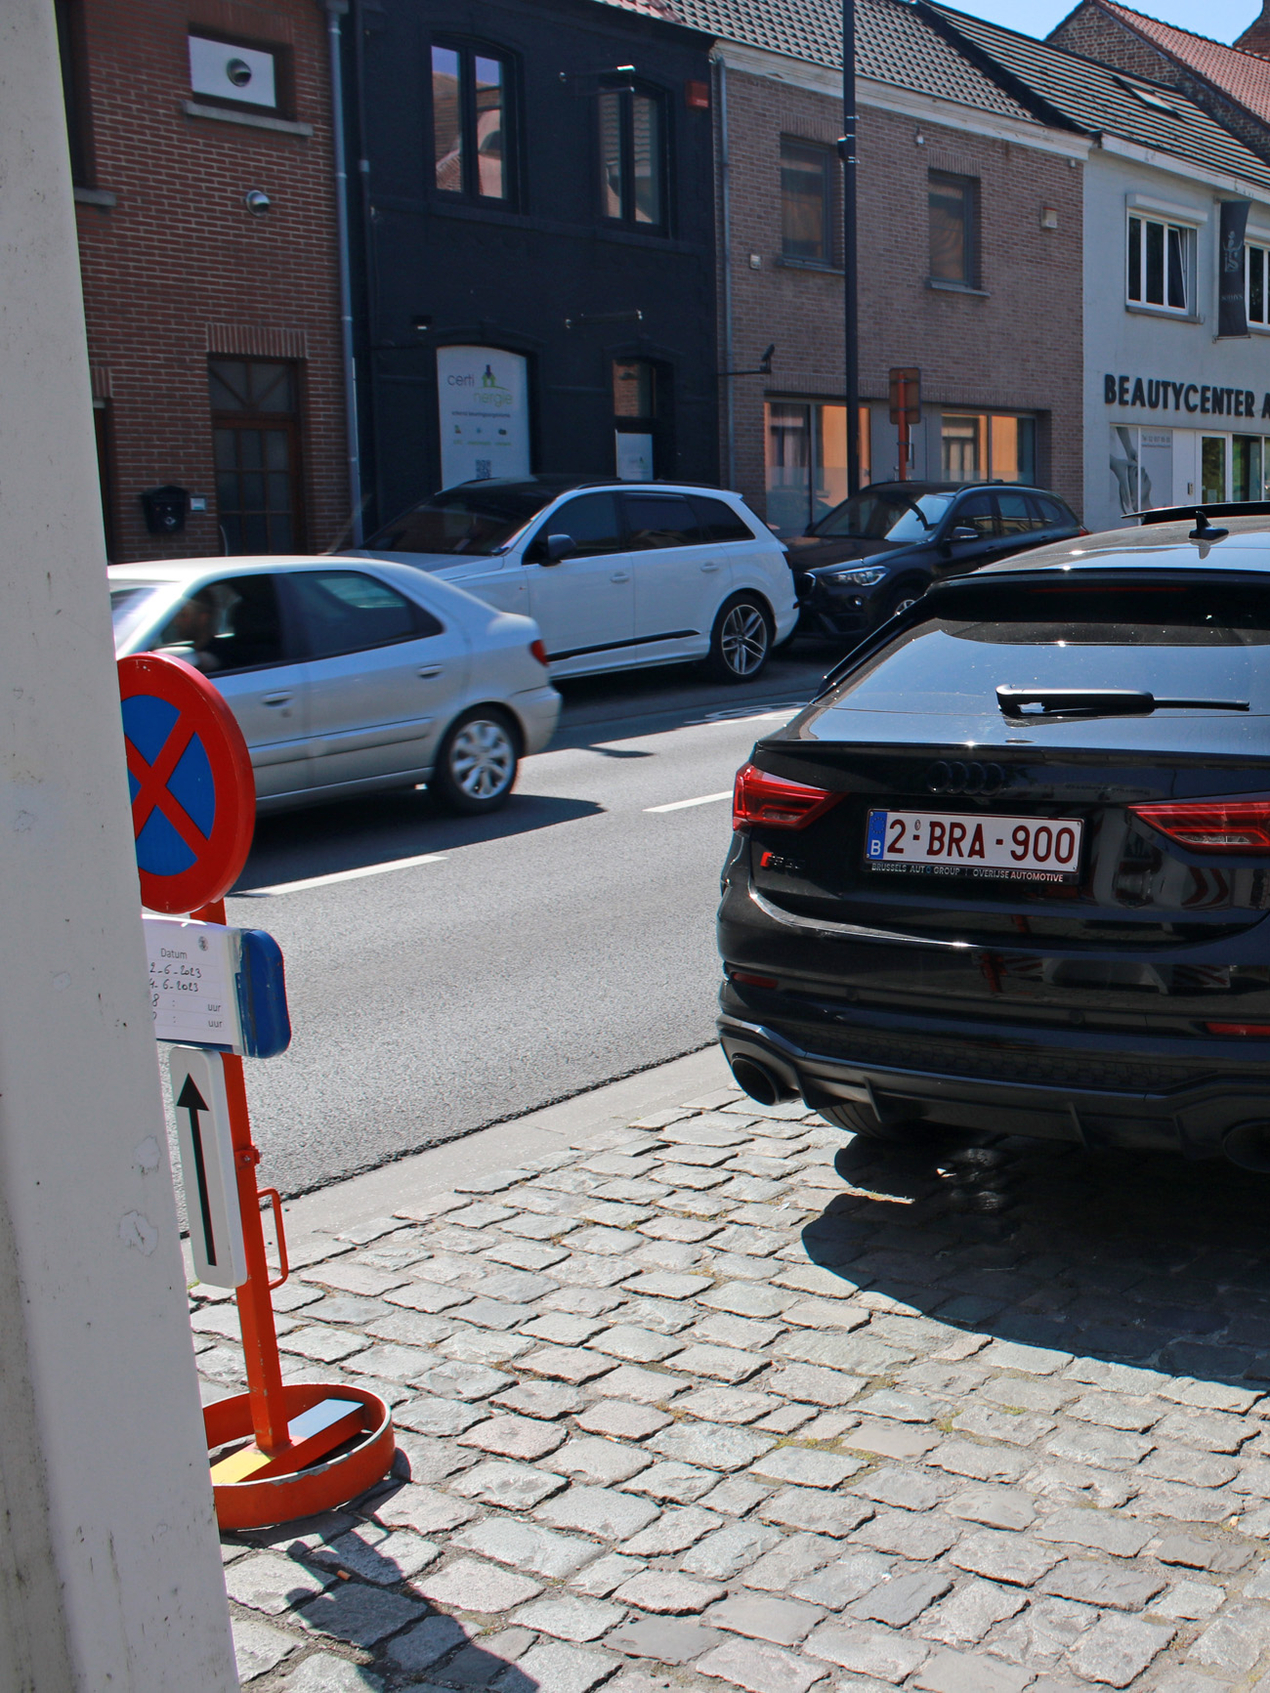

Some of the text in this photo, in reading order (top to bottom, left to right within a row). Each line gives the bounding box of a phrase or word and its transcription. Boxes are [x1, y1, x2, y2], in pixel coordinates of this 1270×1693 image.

[447, 374, 475, 387] certi
[473, 392, 513, 407] nergie
[1104, 374, 1255, 418] BEAUTYCENTER
[870, 840, 881, 855] B
[872, 863, 1064, 882] BRUSSELS AUTO GROUP OVERIJSE AUTOMOTIVE
[160, 948, 188, 959] Datum
[207, 1003, 222, 1012] uur
[208, 1020, 223, 1028] uur
